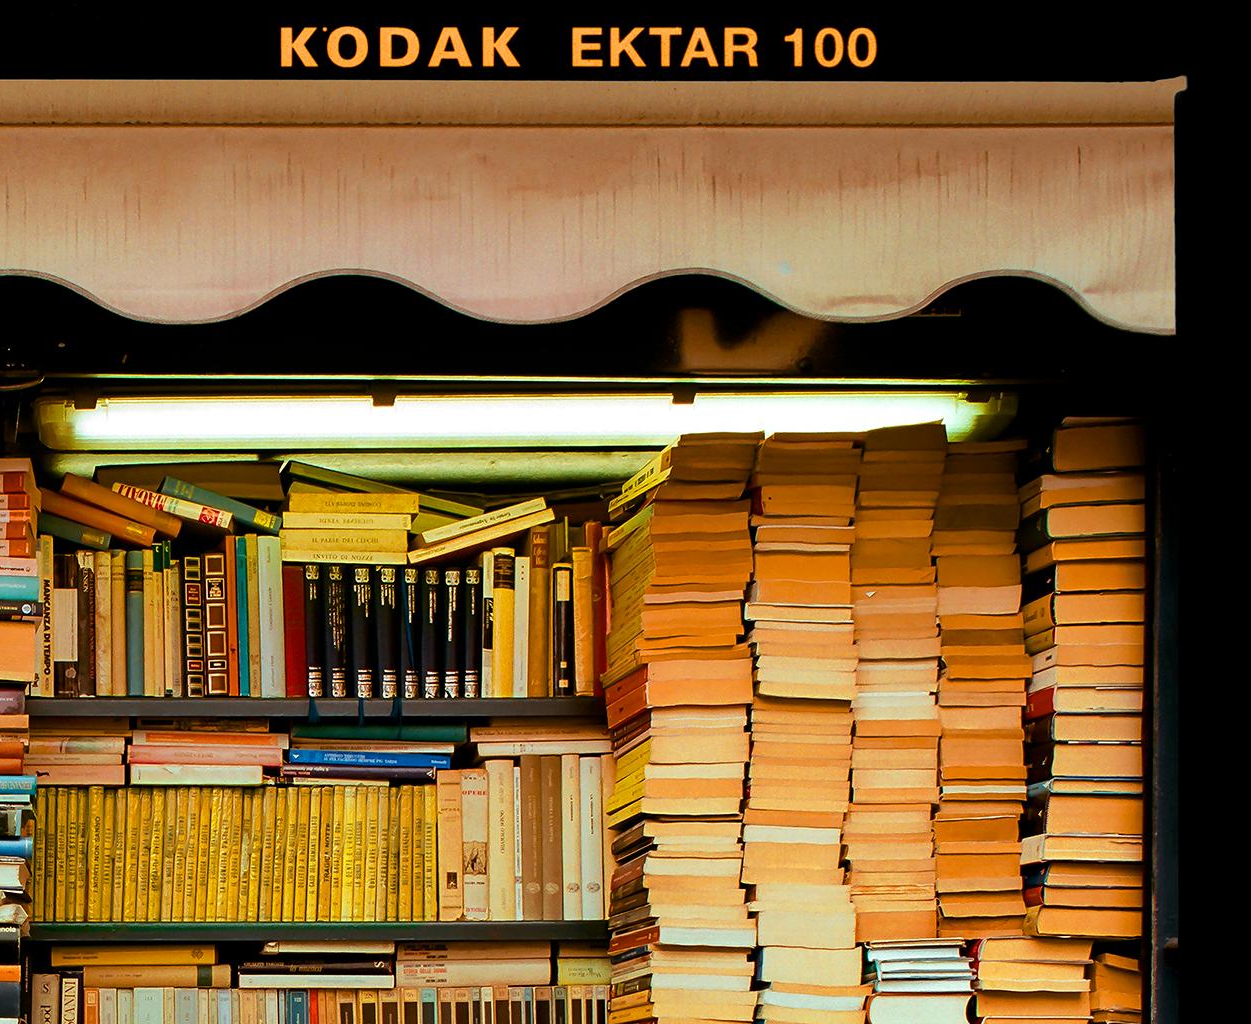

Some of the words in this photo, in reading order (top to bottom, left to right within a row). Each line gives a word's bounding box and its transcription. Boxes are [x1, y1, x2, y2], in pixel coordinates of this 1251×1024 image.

[43, 579, 51, 632] MANCANZA
[43, 633, 51, 643] DI
[43, 644, 51, 676] TEMPO
[93, 844, 101, 862] NON
